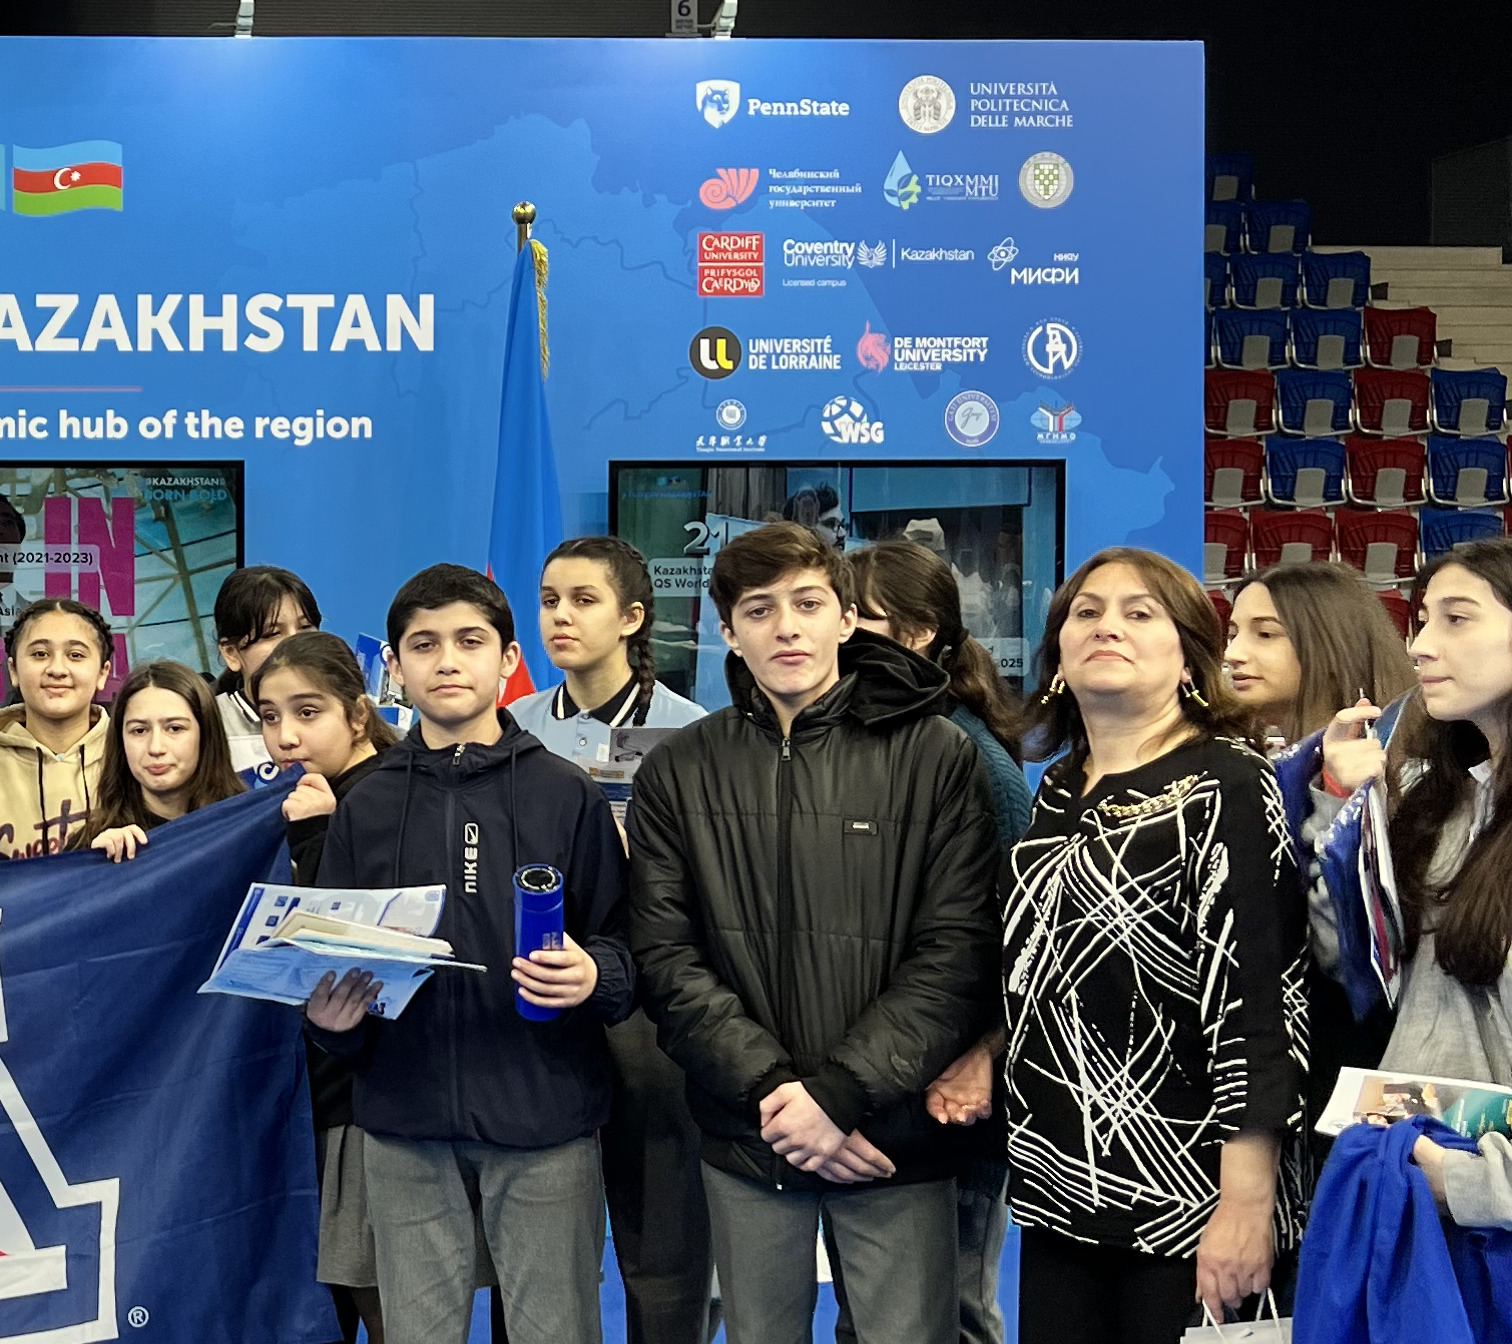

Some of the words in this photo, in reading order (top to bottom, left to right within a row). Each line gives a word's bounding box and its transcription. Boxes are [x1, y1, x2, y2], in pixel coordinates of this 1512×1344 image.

[678, 0, 691, 17] 6
[970, 80, 1058, 96] UNIVERSITÀ
[747, 98, 850, 116] PennState
[970, 98, 1071, 112] POLITECNICA
[970, 114, 1009, 128] DELLE
[1013, 114, 1074, 128] MARCHE
[768, 168, 840, 179] Челябинский
[768, 183, 863, 195] государственный
[965, 186, 999, 198] MTU
[768, 198, 837, 209] университет
[702, 235, 761, 251] CARDIFF
[783, 239, 856, 256] Coventry
[704, 252, 759, 261] UNIVERSITY
[901, 247, 975, 261] Kazakhstan
[784, 253, 855, 269] University
[704, 268, 758, 277] PRIFYSGOL
[1011, 267, 1079, 285] МИФИ
[817, 280, 847, 288] campus
[749, 335, 833, 353] UNIVERSITÉ
[894, 337, 913, 348] DE
[915, 337, 989, 348] MONTFORT
[894, 349, 988, 362] UNIVERSITY
[749, 355, 768, 370] DE
[776, 355, 842, 370] LORRAINE
[894, 362, 942, 371] LEICESTER
[59, 409, 128, 439] hub
[138, 409, 177, 439] of
[184, 409, 244, 439] the
[255, 409, 372, 446] region
[840, 421, 885, 443] WSG
[1037, 432, 1076, 440] МГИМО
[13, 552, 93, 565] (2021-2023)
[654, 565, 714, 576] Kazakhsta
[654, 578, 672, 589] QS
[675, 578, 710, 589] World
[999, 658, 1024, 668] 025
[464, 846, 478, 894] NIKE
